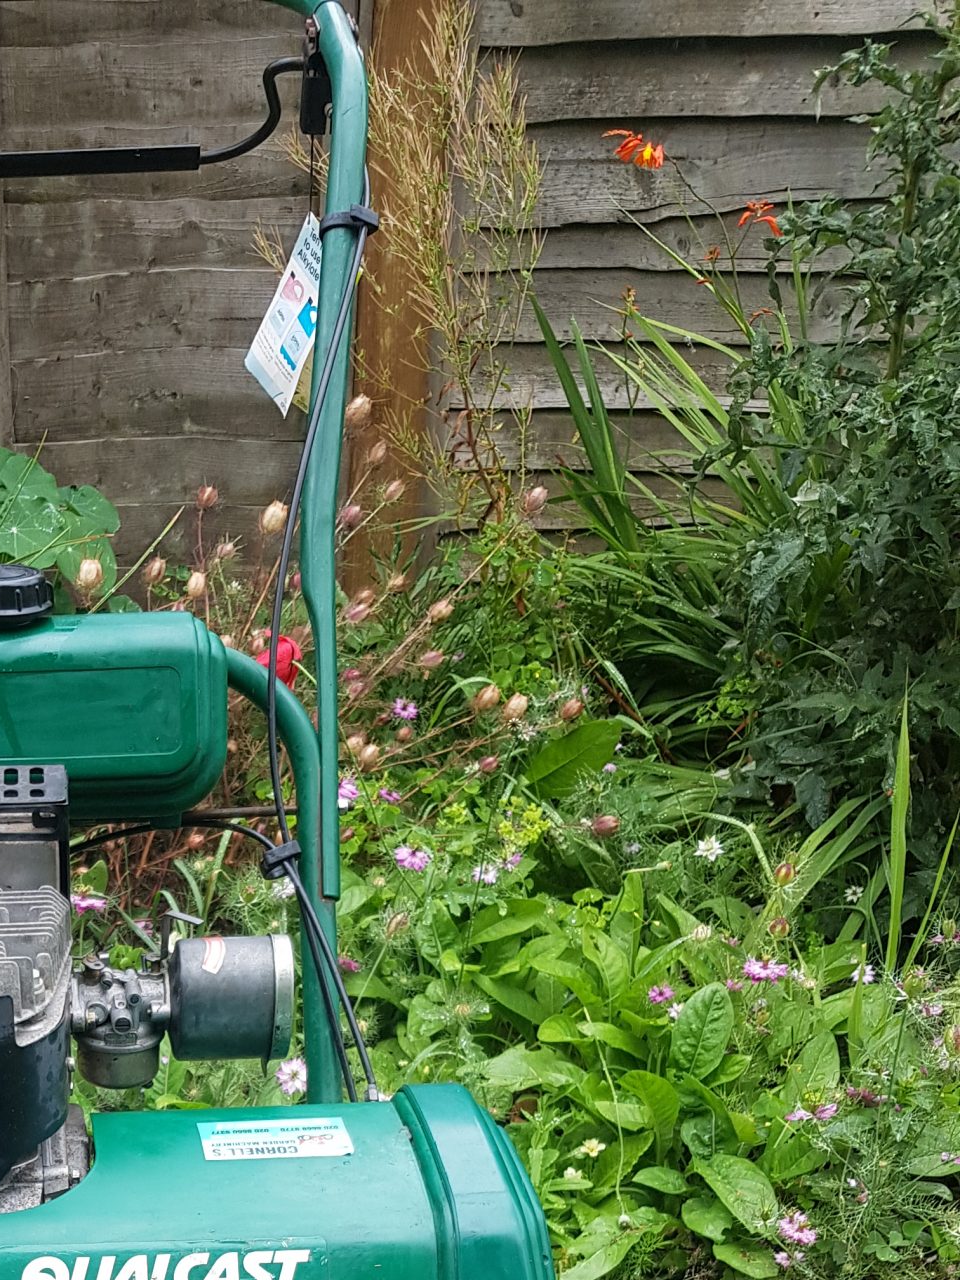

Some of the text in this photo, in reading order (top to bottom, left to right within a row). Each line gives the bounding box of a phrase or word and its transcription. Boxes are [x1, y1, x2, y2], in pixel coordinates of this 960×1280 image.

[309, 227, 321, 247] Ten
[303, 237, 321, 265] to use
[296, 248, 320, 282] Alkylate
[212, 1145, 299, 1156] CORNELL'S
